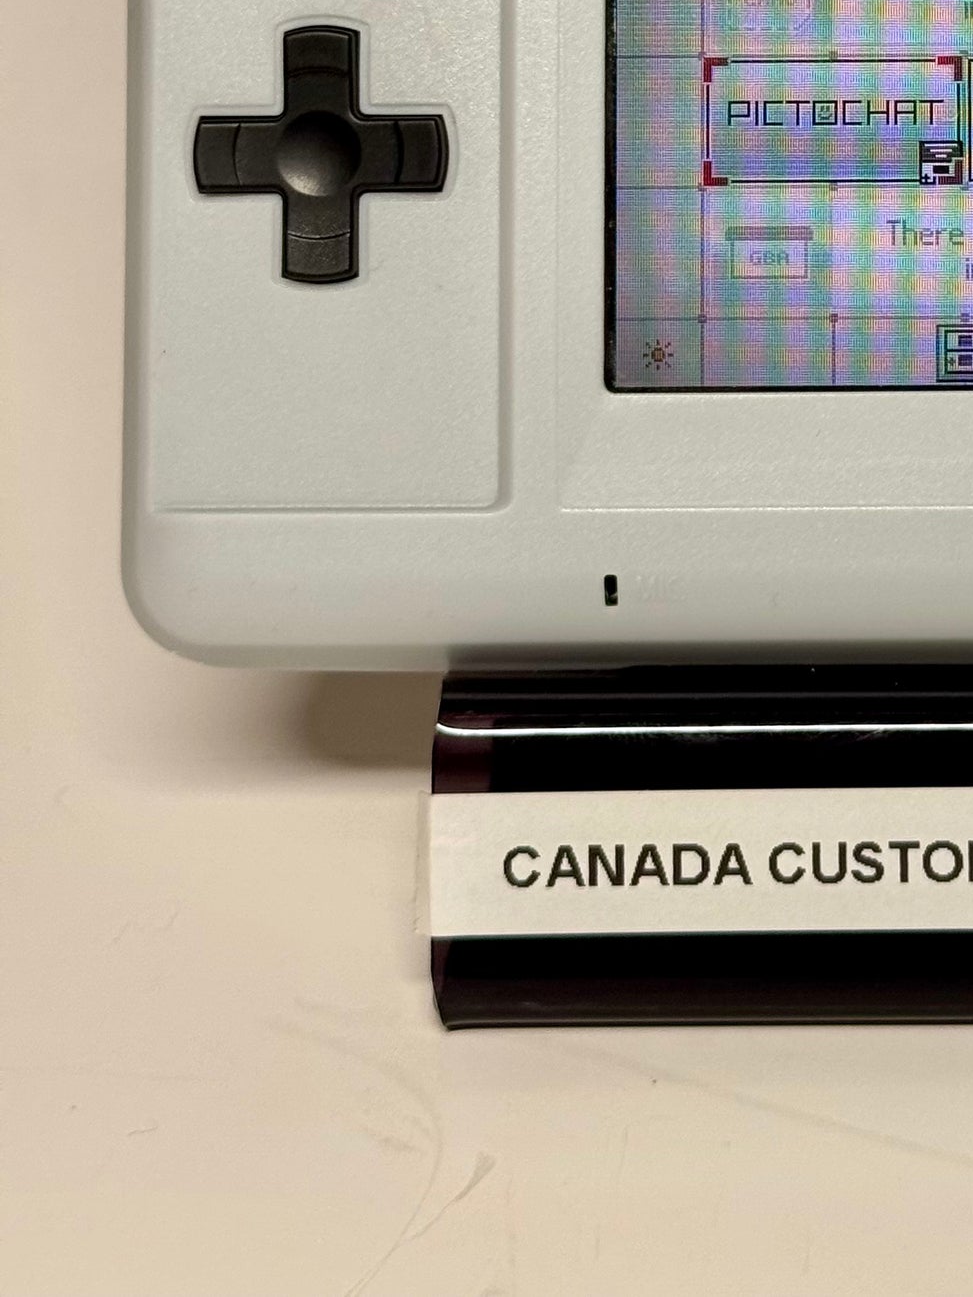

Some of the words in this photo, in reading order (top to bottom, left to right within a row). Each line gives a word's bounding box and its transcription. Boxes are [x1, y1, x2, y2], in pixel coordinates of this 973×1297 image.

[727, 100, 944, 126] PICTOCHAT
[887, 220, 964, 246] There
[750, 251, 789, 265] GBA
[503, 844, 752, 888] CANADA
